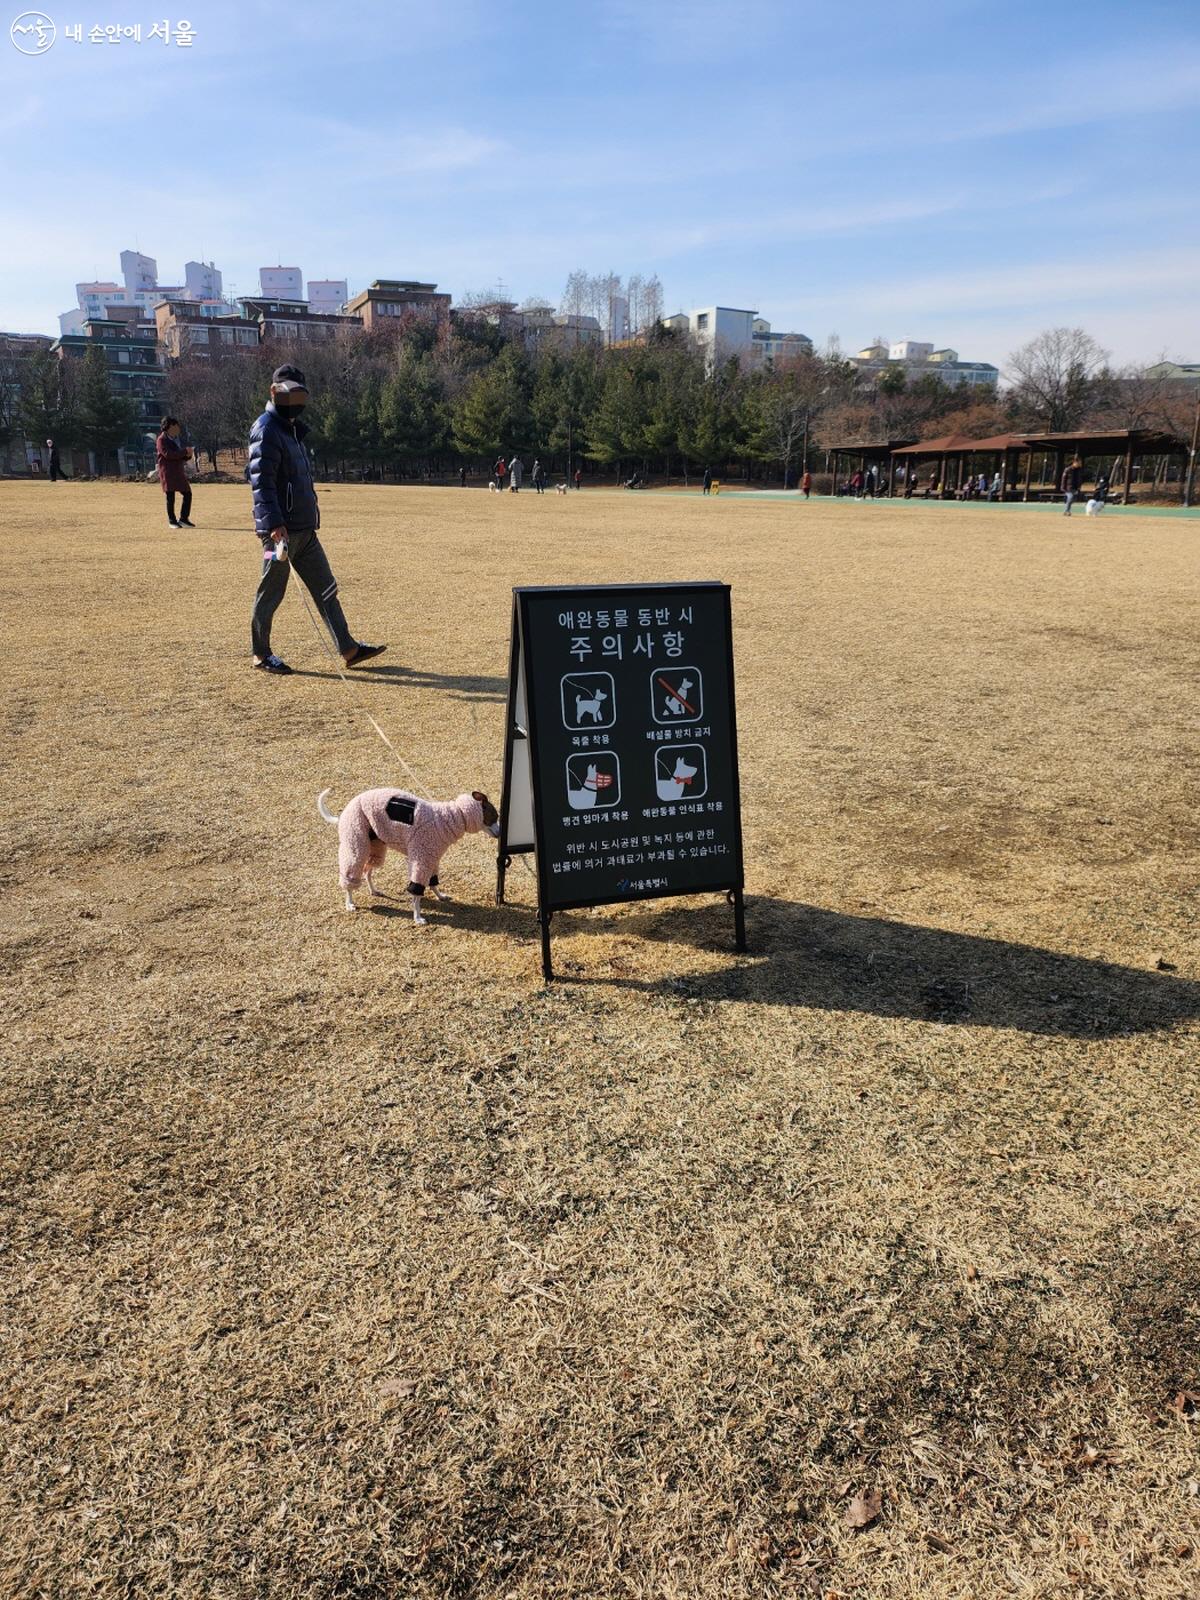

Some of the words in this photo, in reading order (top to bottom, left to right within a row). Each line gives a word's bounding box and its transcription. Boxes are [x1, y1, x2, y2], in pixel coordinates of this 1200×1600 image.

[558, 609, 629, 629] 애완동물
[637, 607, 670, 626] 동반
[678, 606, 693, 624] 시
[569, 631, 685, 662] 주의사항
[572, 736, 590, 747] 목줄
[592, 734, 610, 745] 착용
[646, 729, 672, 741] 배설물
[674, 728, 691, 739] 방치
[694, 726, 711, 737] 금지
[642, 806, 676, 818] 애완동물
[678, 803, 704, 814] 인식표
[706, 801, 723, 812] 착용
[562, 815, 580, 827] 맹견
[582, 812, 610, 825] 입마개
[611, 810, 629, 821] 착용
[566, 842, 586, 854] 위반
[589, 840, 598, 852] 시
[601, 836, 639, 850] 도시공원
[641, 835, 651, 847] 및
[654, 832, 672, 845] 녹지
[675, 830, 694, 843] 등에
[696, 828, 715, 841] 관한
[552, 859, 582, 873] 법률에
[584, 857, 603, 869] 의거
[647, 849, 675, 862] 부과될
[678, 848, 687, 859] 수
[689, 843, 730, 857] 있습니다.
[629, 876, 669, 890] 서울특별시
